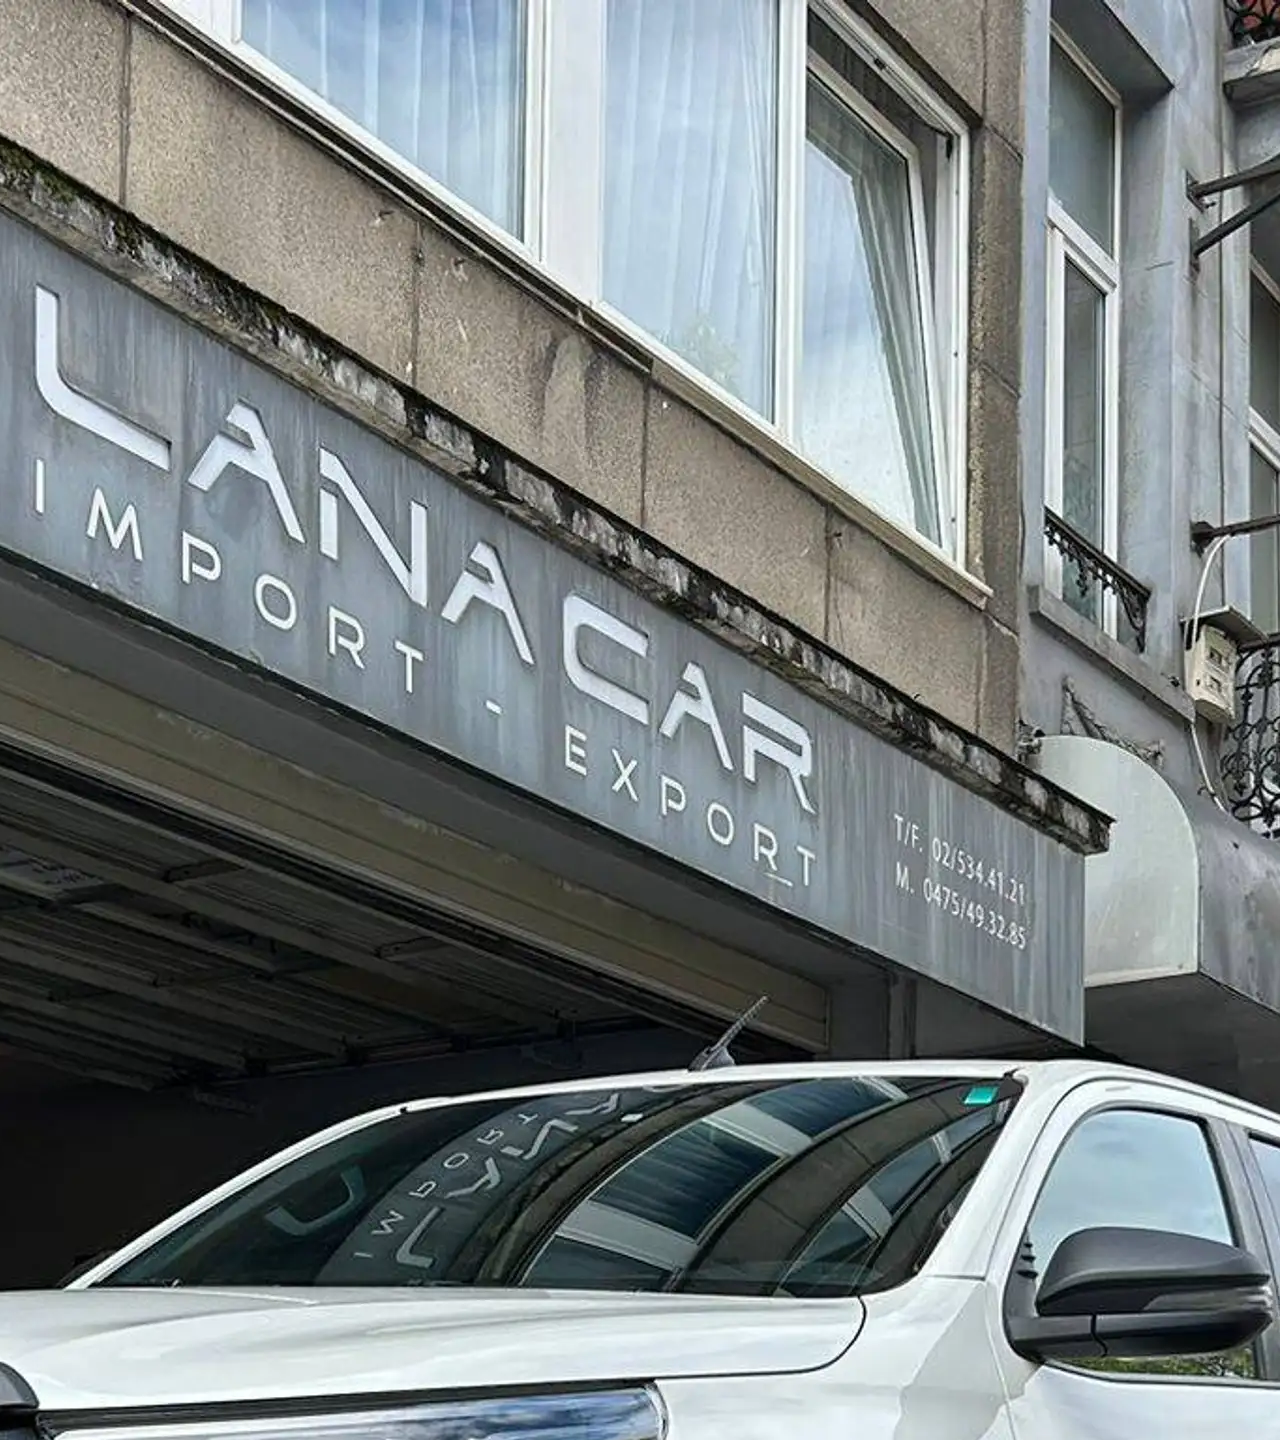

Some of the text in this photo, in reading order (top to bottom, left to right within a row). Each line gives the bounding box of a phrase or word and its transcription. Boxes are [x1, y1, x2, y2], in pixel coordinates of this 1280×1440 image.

[34, 458, 425, 694] IMPORT
[565, 724, 816, 887] EXPORT
[895, 861, 915, 894] M.
